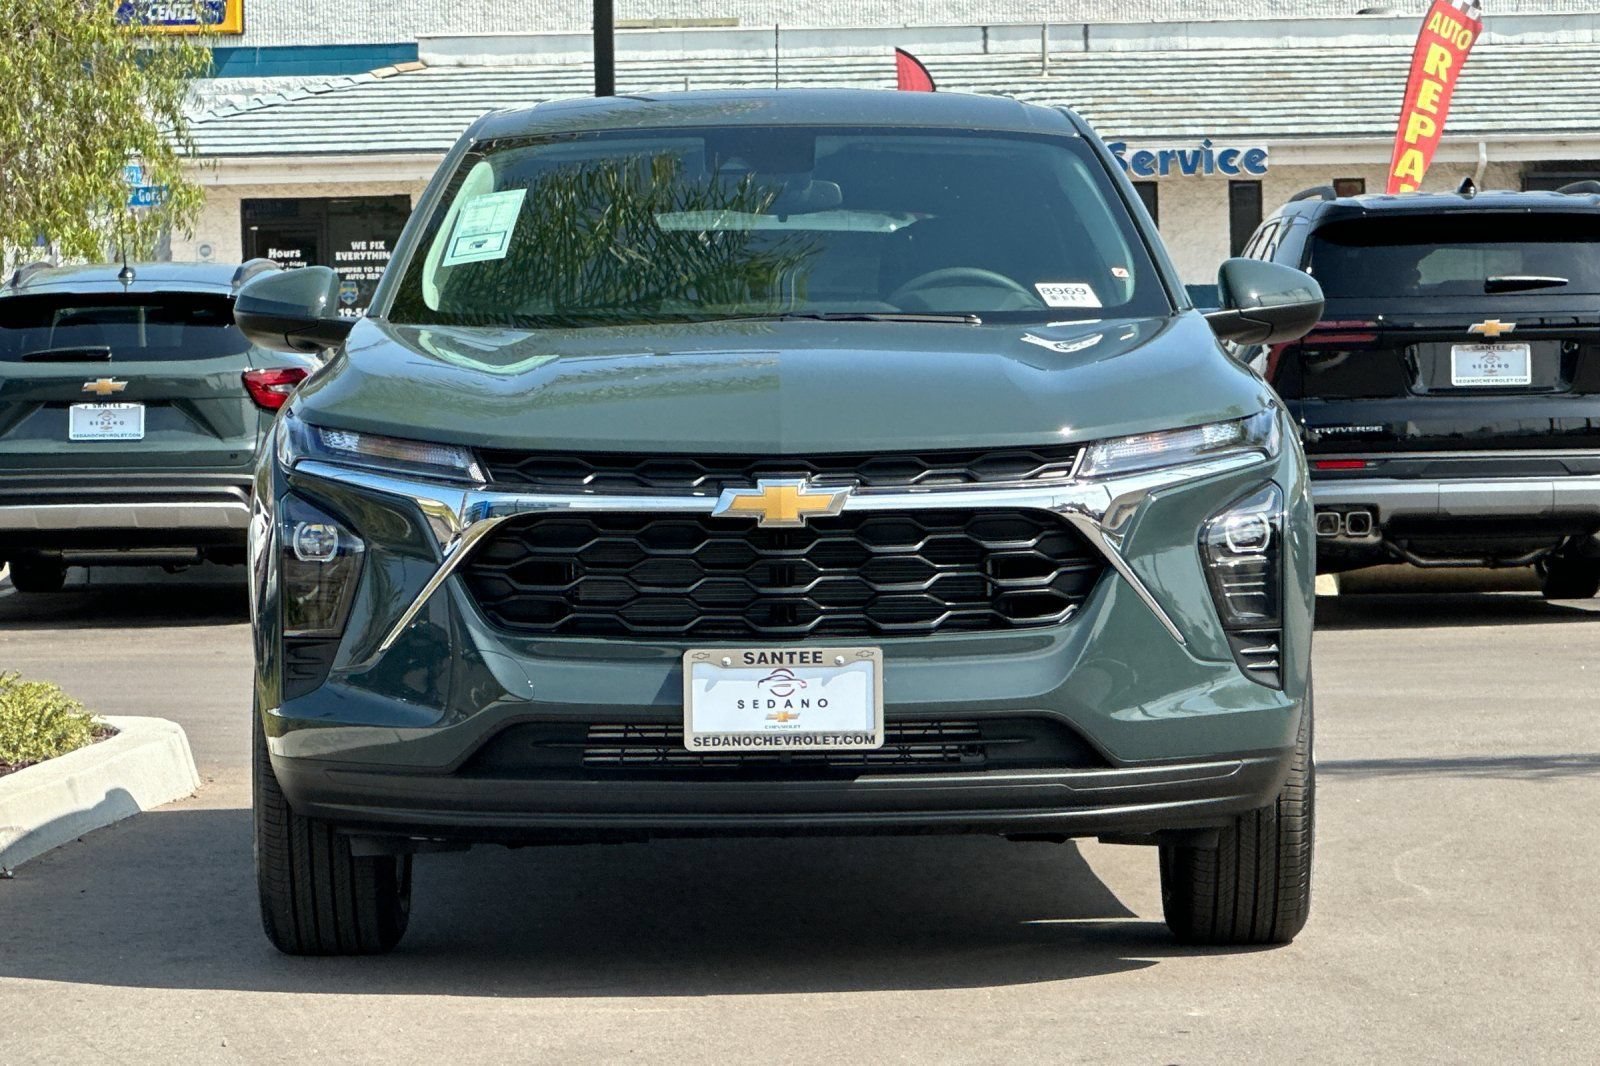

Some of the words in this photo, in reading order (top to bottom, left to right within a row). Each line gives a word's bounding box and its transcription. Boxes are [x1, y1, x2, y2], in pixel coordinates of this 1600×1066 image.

[148, 3, 204, 20] CENTE
[1427, 11, 1473, 51] AUTO
[1107, 137, 1268, 177] Service
[351, 241, 367, 250] WE
[369, 241, 385, 250] FIX
[268, 248, 301, 258] Hours
[335, 251, 391, 261] EVERYTHIN
[1041, 287, 1087, 296] 8969
[743, 651, 823, 665] SANTEE
[737, 698, 829, 710] SEDANO
[693, 735, 876, 747] SEDANOCHEVROLET.COM
